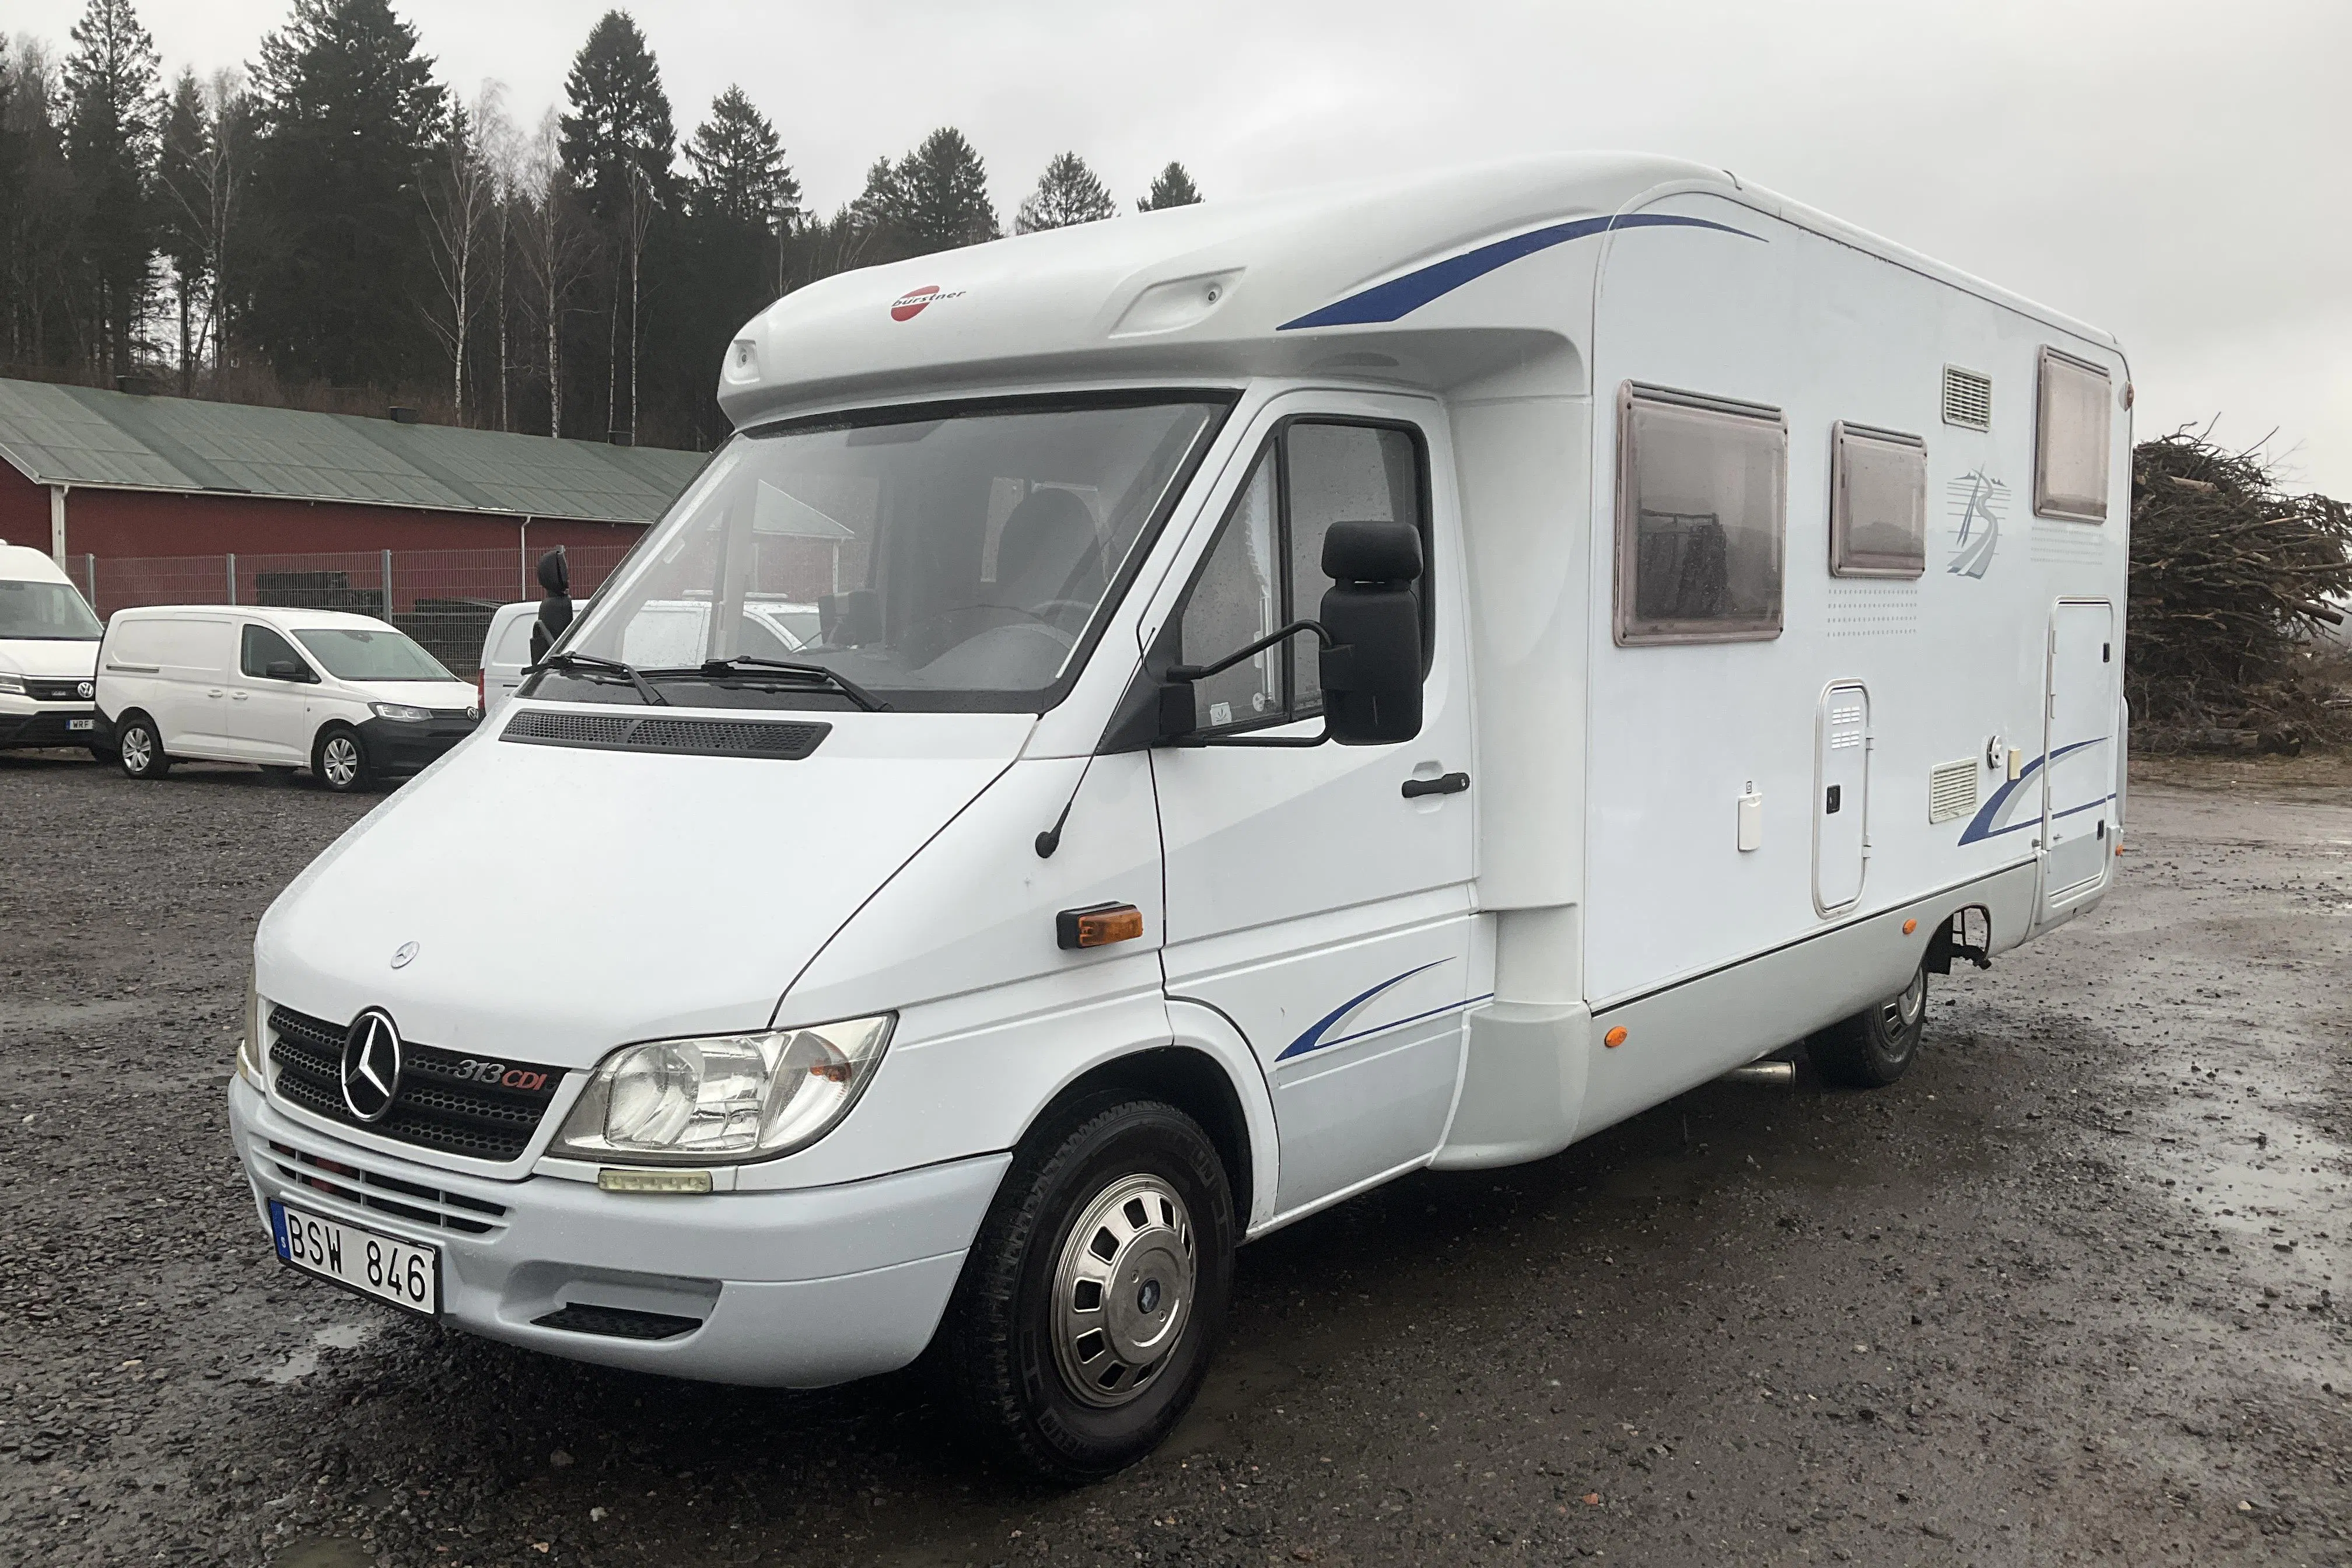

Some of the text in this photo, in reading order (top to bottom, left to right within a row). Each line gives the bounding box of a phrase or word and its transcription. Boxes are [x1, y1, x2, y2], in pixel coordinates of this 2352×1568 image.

[72, 720, 89, 729] WRF
[281, 1236, 286, 1248] S
[288, 1213, 426, 1302] BSW 846
